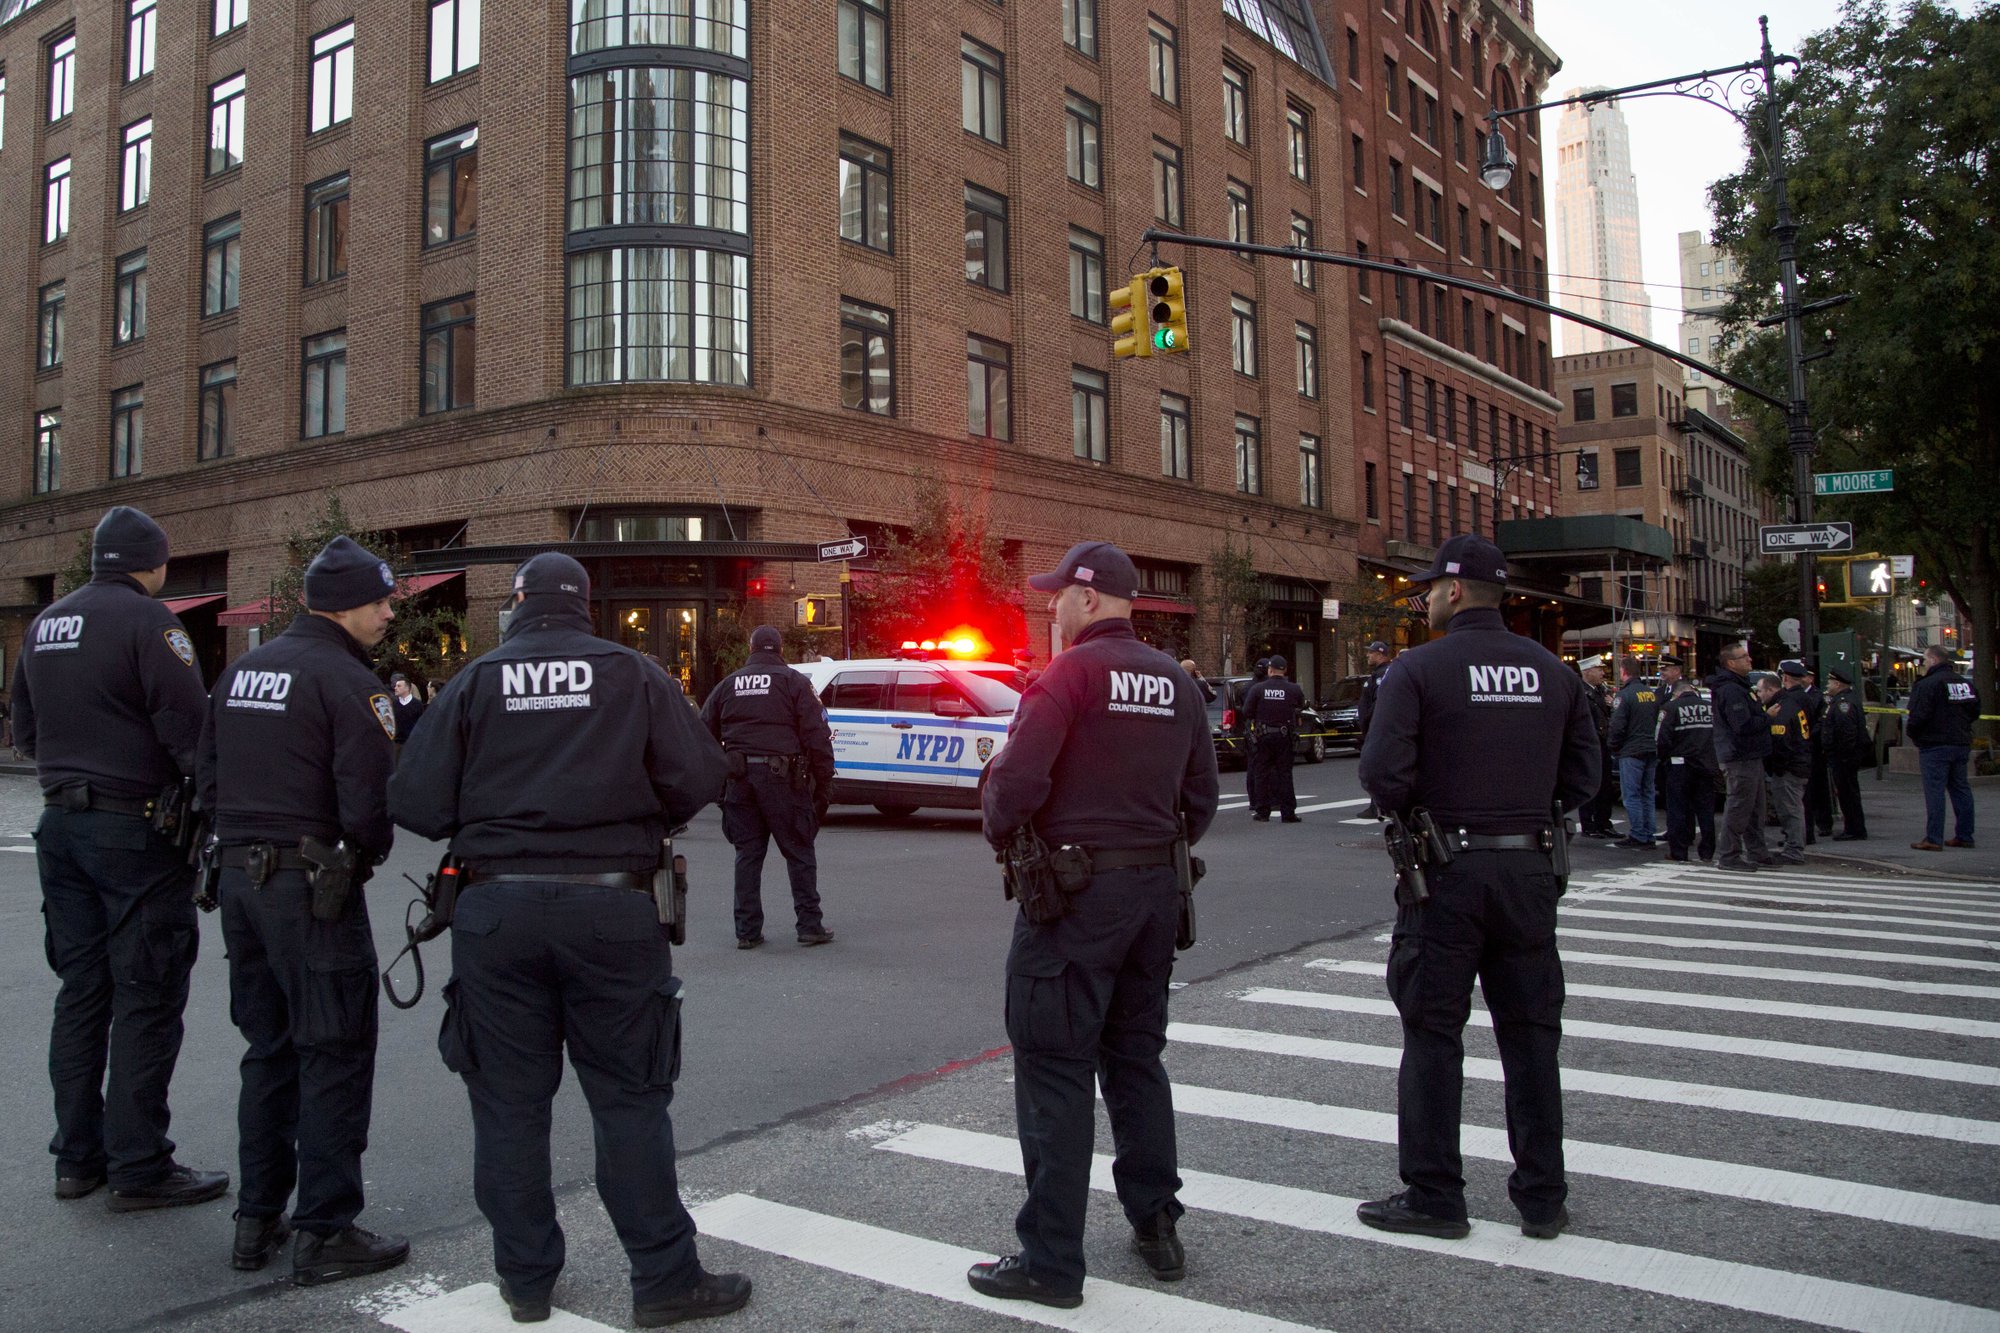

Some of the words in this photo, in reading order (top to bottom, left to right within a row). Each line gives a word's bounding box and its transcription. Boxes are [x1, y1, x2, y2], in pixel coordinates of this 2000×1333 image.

[1817, 478, 1827, 492] N
[1832, 473, 1877, 491] MOORE
[1879, 472, 1889, 482] ST
[1769, 533, 1795, 545] ONE
[1810, 531, 1838, 543] WAY
[823, 548, 837, 556] ONE
[840, 544, 854, 553] WAY
[560, 583, 578, 593] CRC
[36, 615, 84, 643] NYPD
[1836, 651, 1845, 660] 7
[502, 660, 593, 695] NYPD
[734, 674, 771, 690] NYPD
[1469, 665, 1540, 693] NYPD
[230, 670, 292, 700] NYPD
[1110, 670, 1175, 706] NYPD
[1947, 683, 1971, 696] NYPD
[1265, 689, 1285, 698] NYPD
[1471, 693, 1542, 703] COUNTERTERRORISM
[1636, 691, 1656, 703] NYPD
[226, 699, 286, 711] COUNTERTERRORISM
[506, 694, 591, 711] COUNTERTERRORISM
[1108, 702, 1175, 717] COUNTERTERRORISM
[1680, 715, 1713, 725] POLIC
[896, 733, 965, 763] NYPD
